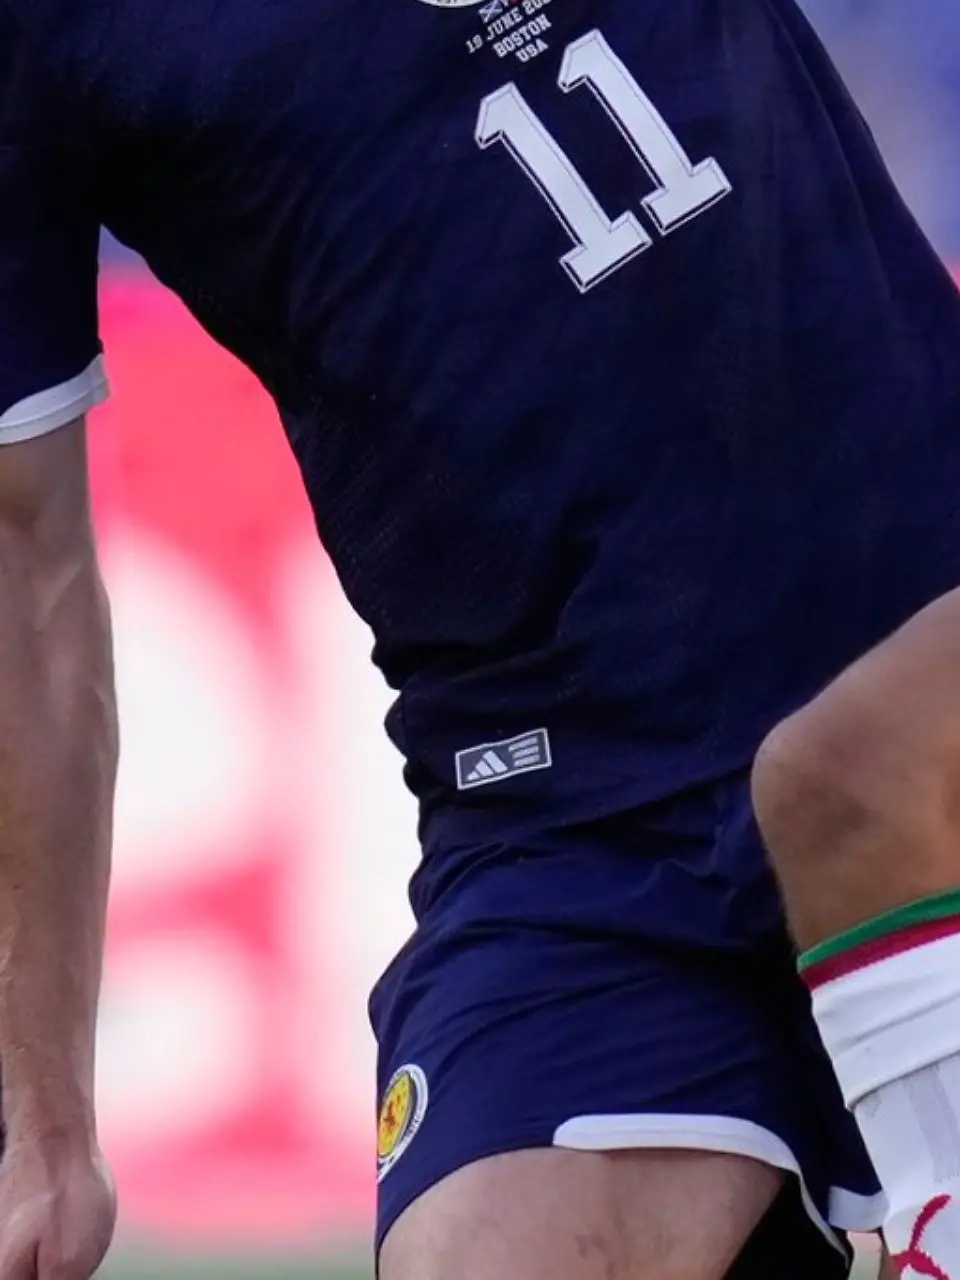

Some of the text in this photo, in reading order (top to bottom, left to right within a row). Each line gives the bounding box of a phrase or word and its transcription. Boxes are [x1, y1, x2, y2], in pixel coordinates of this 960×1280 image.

[486, 7, 524, 41] JUNE
[492, 13, 552, 58] BOSTON
[515, 38, 549, 63] USA
[474, 28, 732, 293] 11
